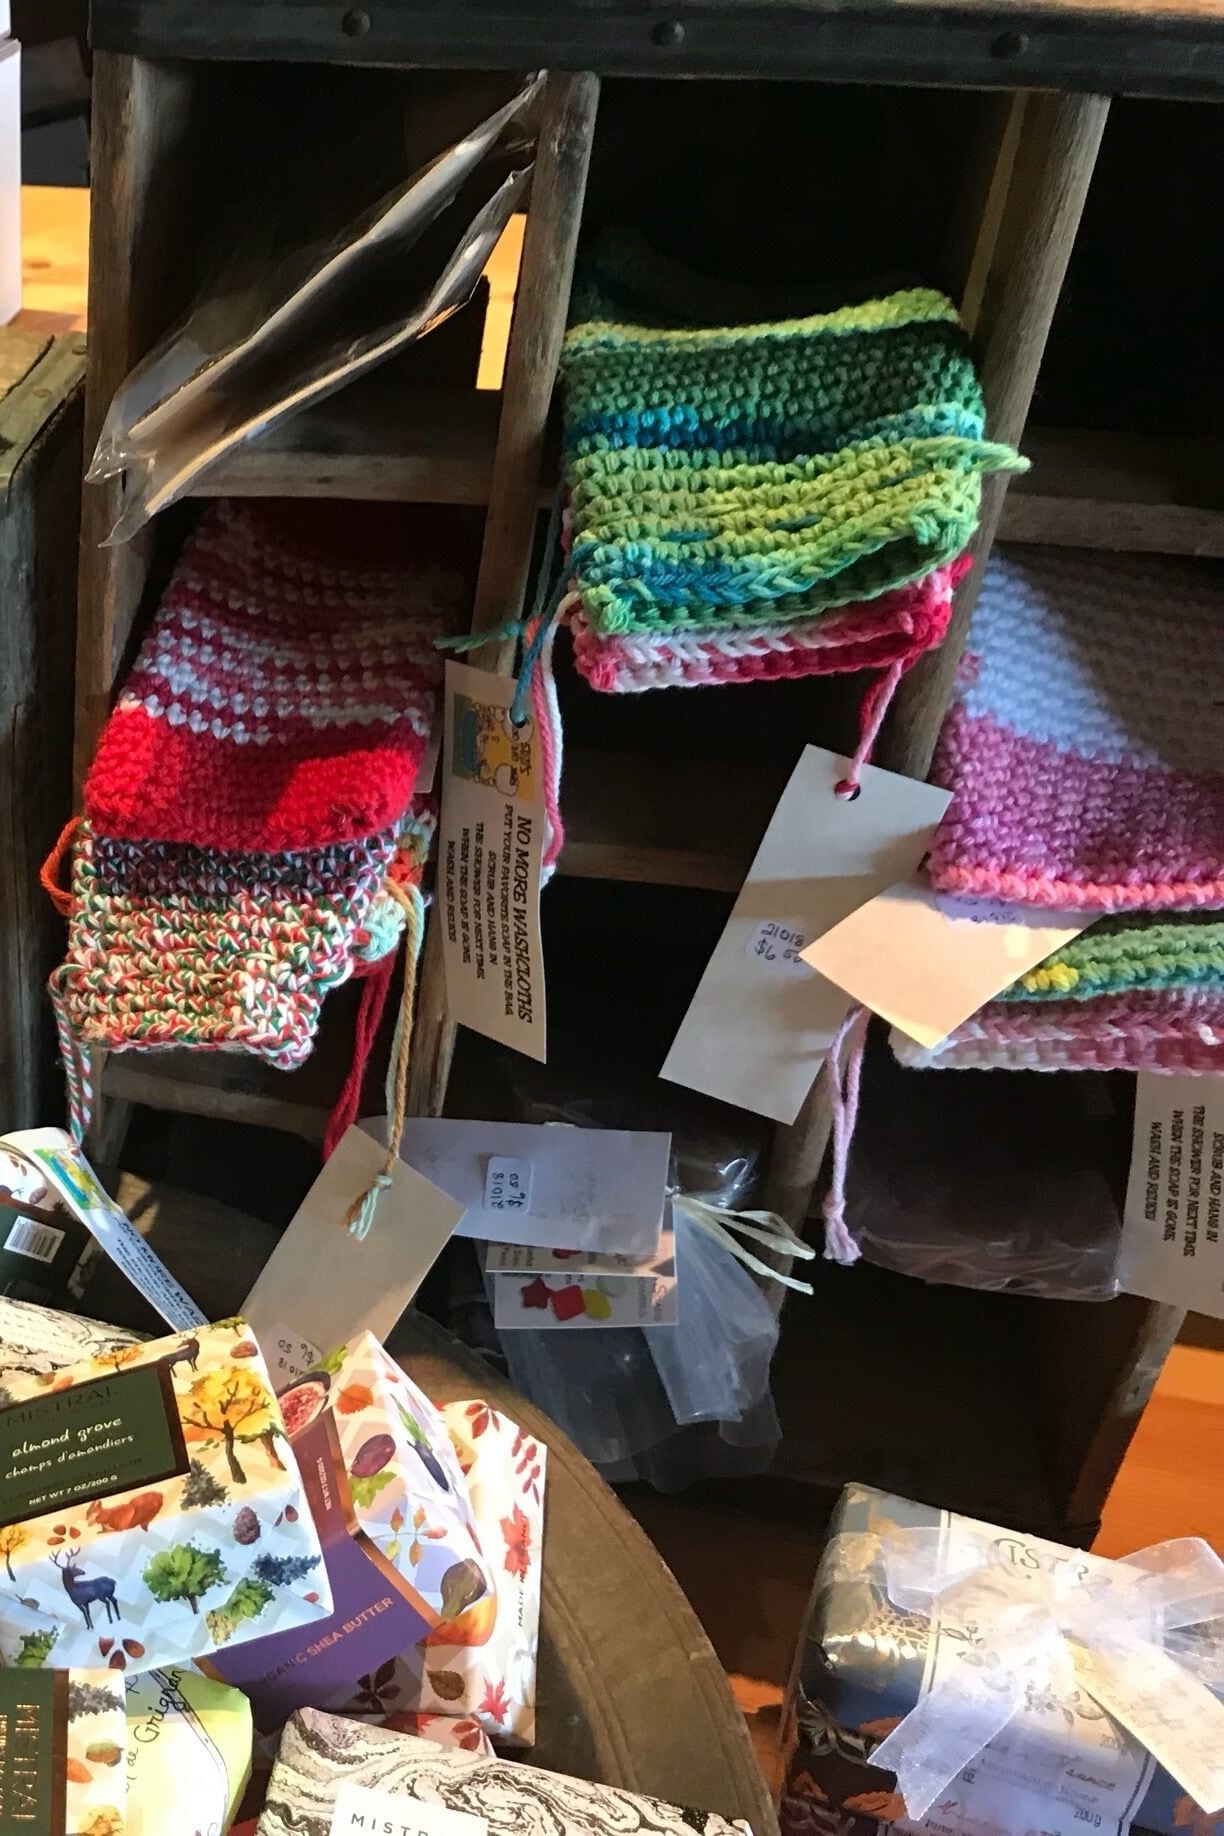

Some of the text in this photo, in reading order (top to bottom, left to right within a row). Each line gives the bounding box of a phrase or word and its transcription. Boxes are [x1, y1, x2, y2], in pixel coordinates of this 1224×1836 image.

[503, 804, 513, 827] PUT
[460, 828, 470, 863] WHEN
[475, 822, 484, 844] THE
[502, 828, 512, 863] YOUR
[446, 840, 456, 877] WASH
[473, 846, 483, 896] SHOWER
[487, 850, 497, 890] SCRUB
[445, 879, 455, 903] AND
[459, 865, 468, 888] THE
[500, 864, 511, 919] FAVORITE
[460, 889, 469, 919] SOAP
[473, 897, 482, 919] FOR
[486, 891, 496, 919] AND
[512, 815, 533, 1024] NO MORE WASHCLOTHS
[474, 920, 484, 951] NEXT
[487, 920, 497, 951] HANG
[500, 921, 512, 953] SOAP
[760, 923, 805, 947] 21018
[503, 968, 513, 989] THE
[1171, 1110, 1184, 1143] WHEN
[1192, 1105, 1205, 1126] THE
[1149, 1121, 1163, 1154] WASH
[1190, 1127, 1204, 1174] SHOWER
[1147, 1155, 1160, 1181] AND
[1169, 1144, 1182, 1165] THE
[1167, 1166, 1180, 1197] SOAP
[1188, 1176, 1201, 1199] FOR
[1210, 1170, 1222, 1196] AND
[1186, 1200, 1199, 1229] NEXT
[1208, 1197, 1221, 1229] HANG
[11, 1417, 123, 1458] almond grove
[4, 1459, 53, 1480] champs
[57, 1434, 135, 1463] d'amandiers
[28, 1494, 47, 1506] NET
[49, 1488, 65, 1499] WT
[73, 1476, 109, 1492] OZ/200
[306, 1596, 395, 1658] SHEA BUTTER
